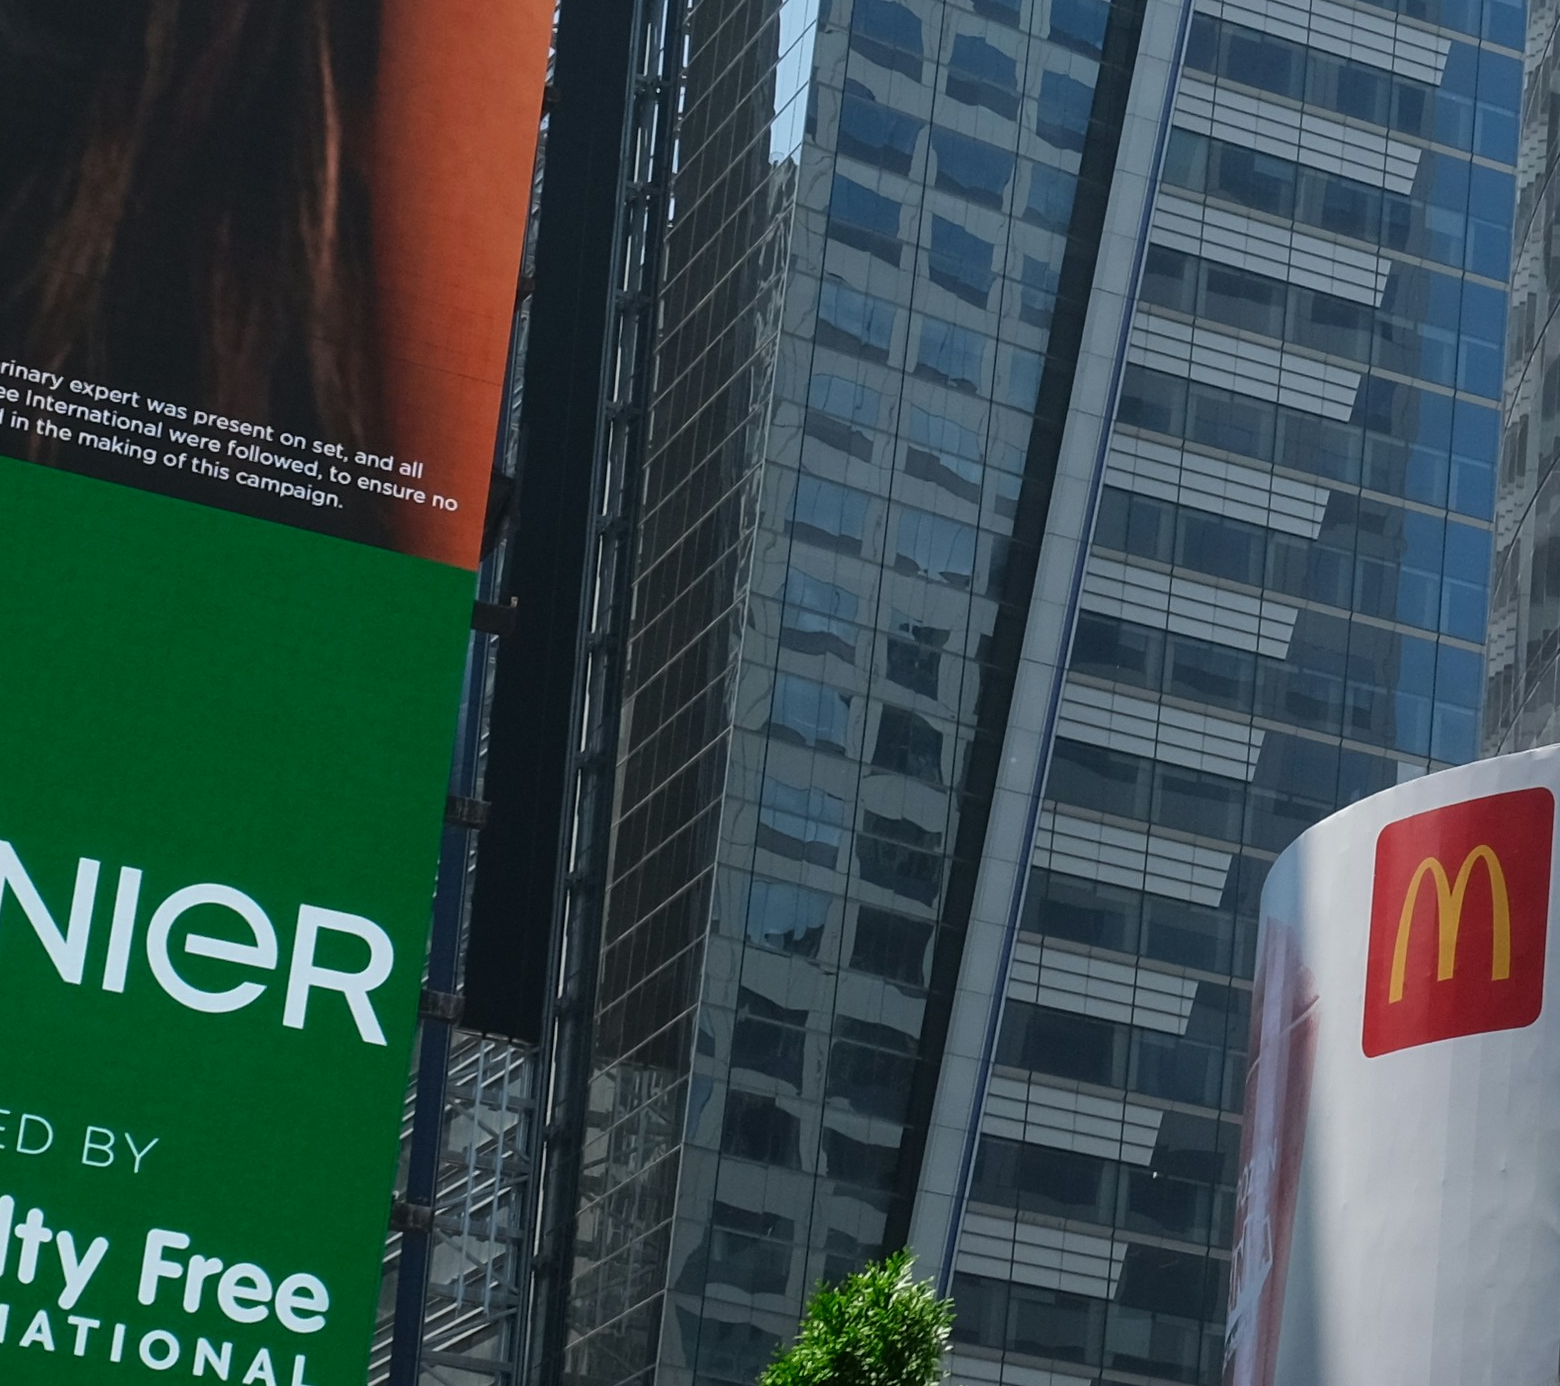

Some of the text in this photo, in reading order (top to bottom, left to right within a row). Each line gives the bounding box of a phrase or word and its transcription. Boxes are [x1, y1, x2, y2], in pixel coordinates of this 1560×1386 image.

[10, 411, 29, 431] in
[36, 419, 72, 441] the
[78, 432, 157, 465] making
[163, 452, 187, 469] of
[191, 457, 230, 480] this
[235, 471, 343, 508] campaign.
[25, 389, 163, 438] International
[169, 428, 221, 453] were
[227, 439, 322, 480] followed,
[330, 466, 352, 485] to
[357, 476, 426, 504] ensure
[432, 494, 458, 511] no
[69, 380, 139, 408] expert
[147, 398, 187, 420] was
[193, 410, 274, 442] present
[279, 433, 306, 450] on
[312, 440, 348, 463] set,
[354, 451, 394, 471] and
[399, 461, 424, 479] all
[82, 1126, 160, 1174] BY
[137, 1228, 330, 1334] Free
